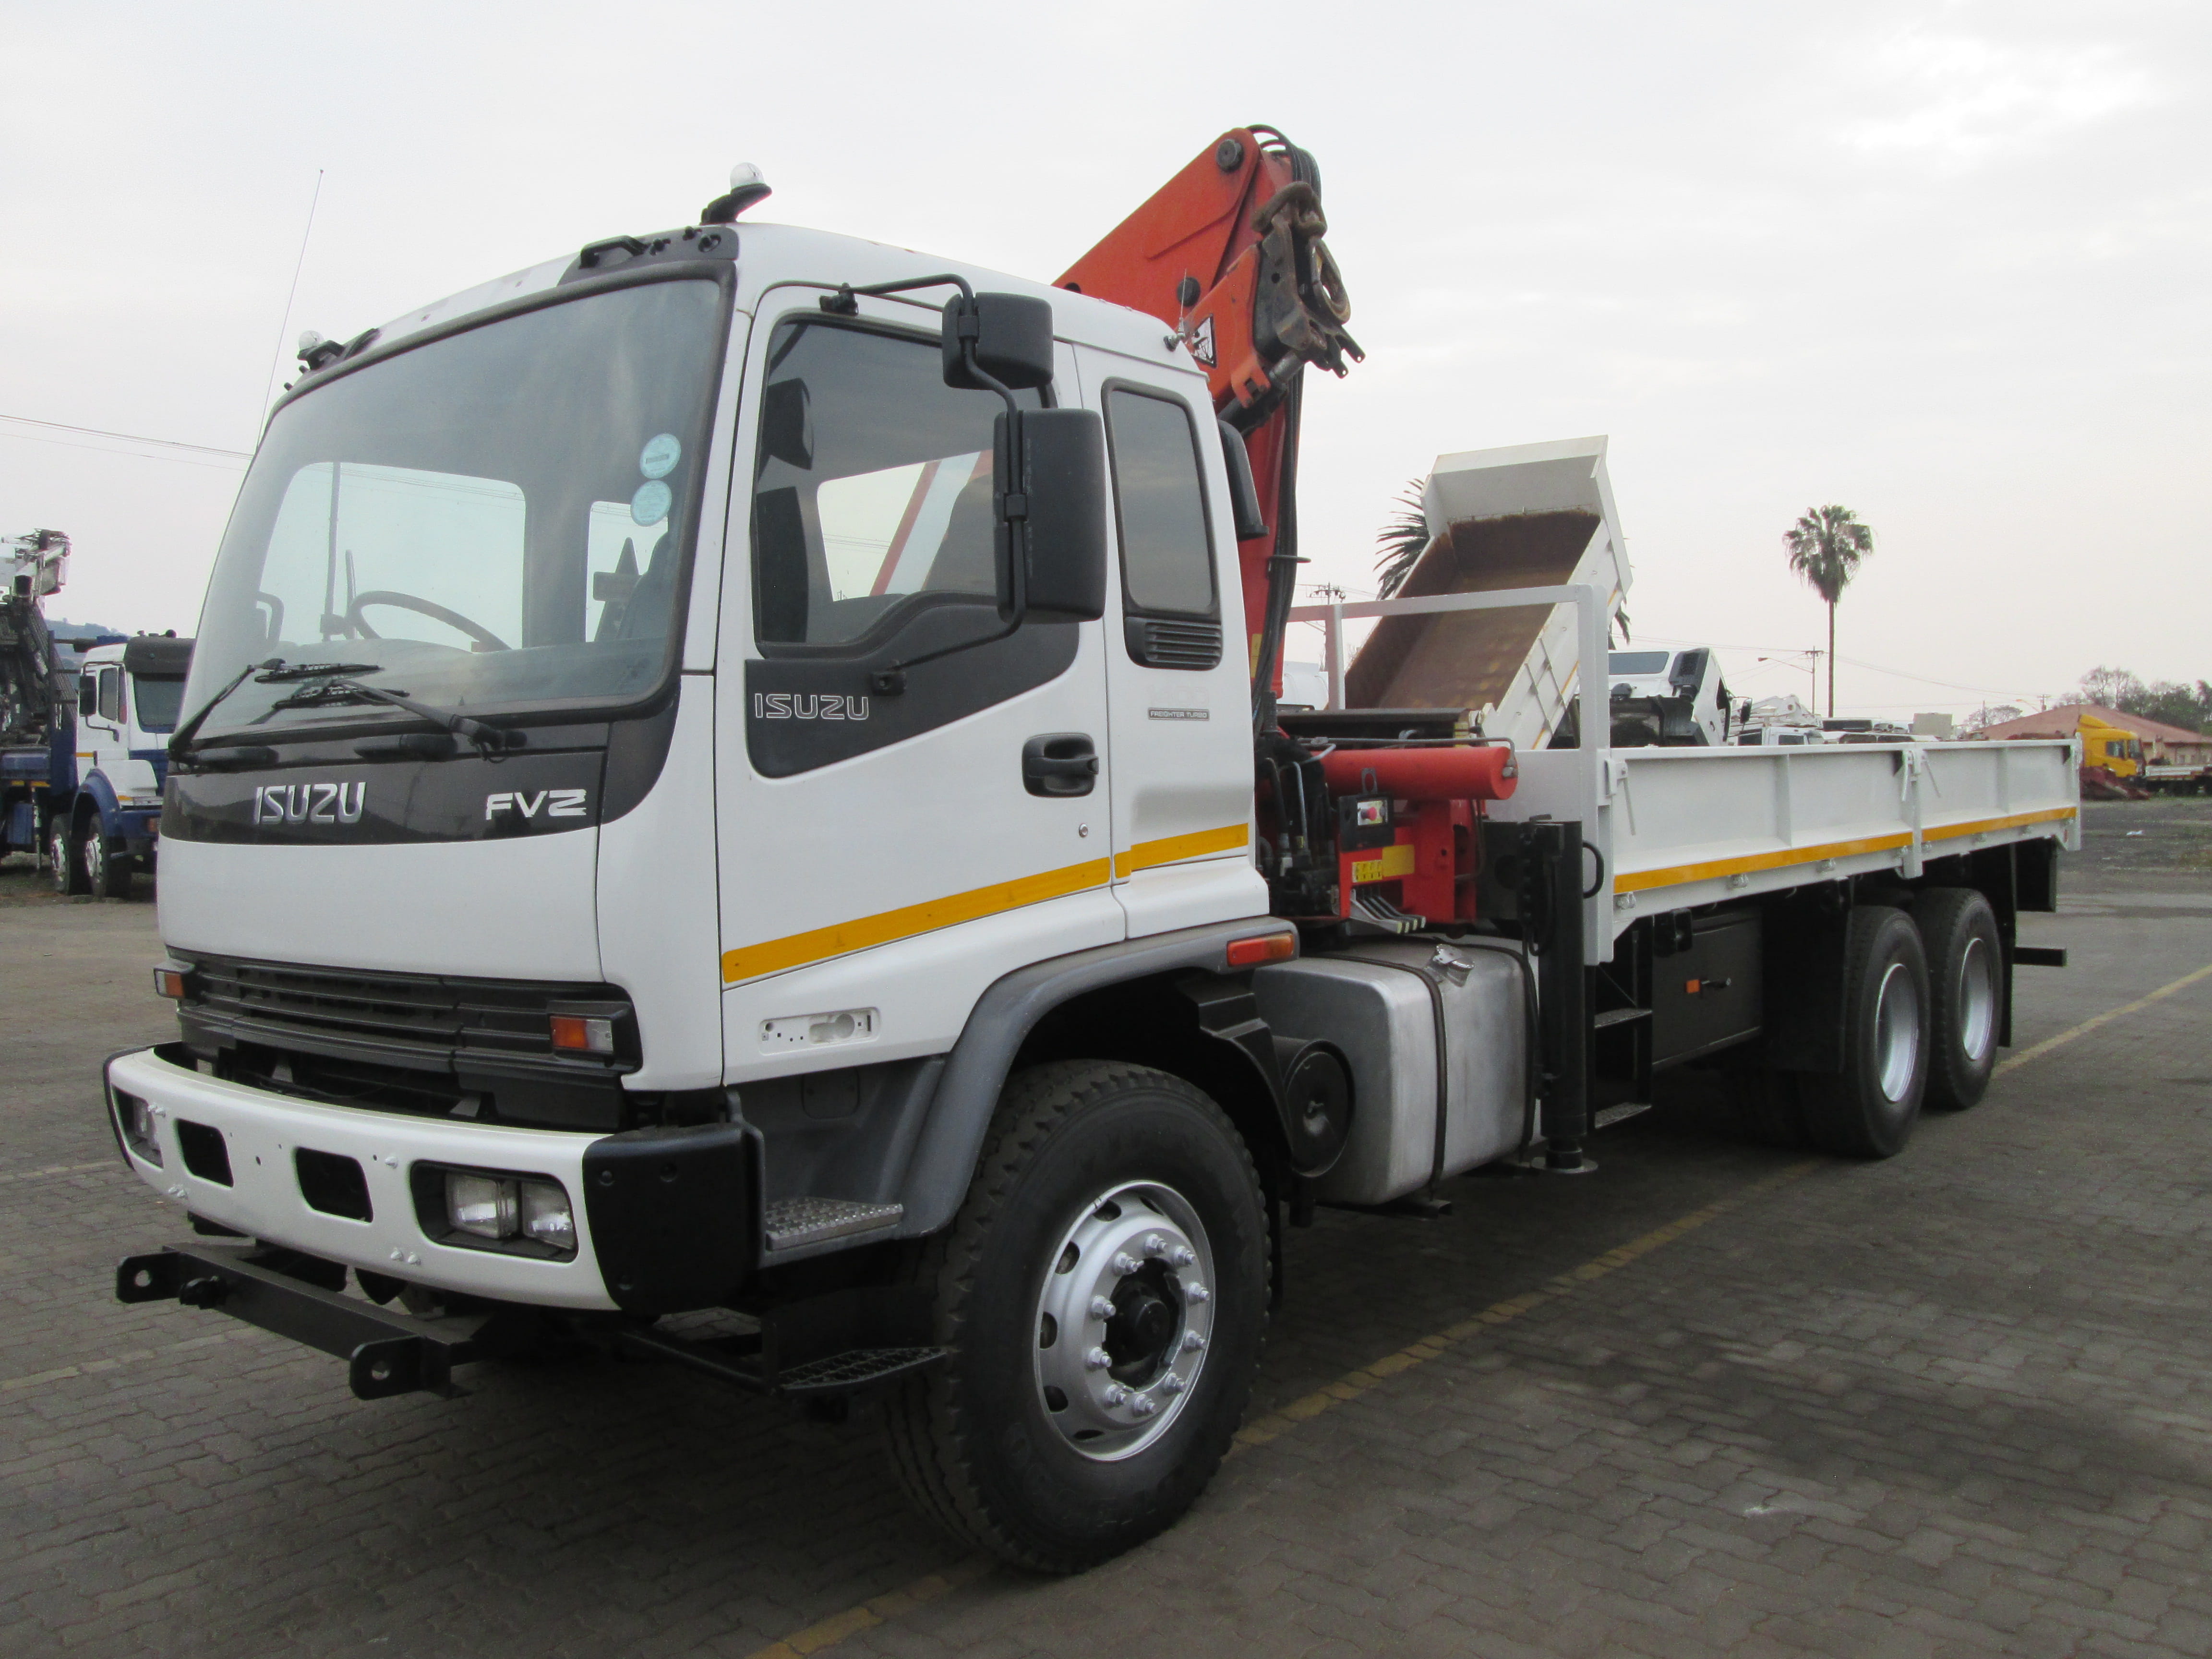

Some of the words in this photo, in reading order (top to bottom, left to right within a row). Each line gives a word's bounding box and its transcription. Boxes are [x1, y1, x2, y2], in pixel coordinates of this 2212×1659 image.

[755, 693, 869, 720] ISUZU
[253, 781, 366, 825] ISUZU
[485, 789, 587, 820] FVZ
